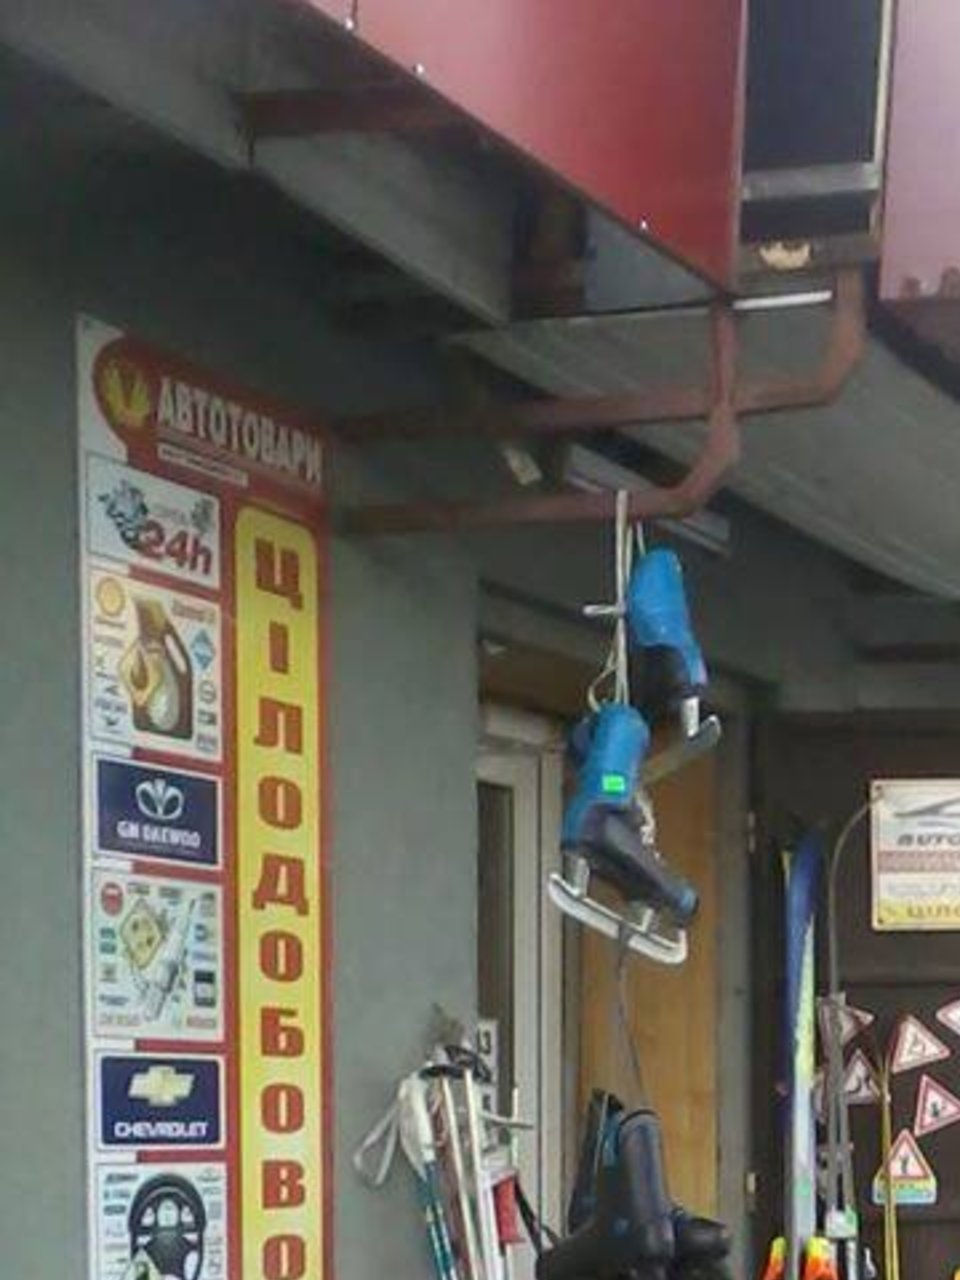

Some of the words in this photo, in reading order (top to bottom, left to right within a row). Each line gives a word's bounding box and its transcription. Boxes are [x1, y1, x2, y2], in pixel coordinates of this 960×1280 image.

[157, 376, 323, 484] АВТОТОВАРИ
[142, 823, 202, 849] DAEWOO
[114, 1120, 209, 1139] CHEVROLET
